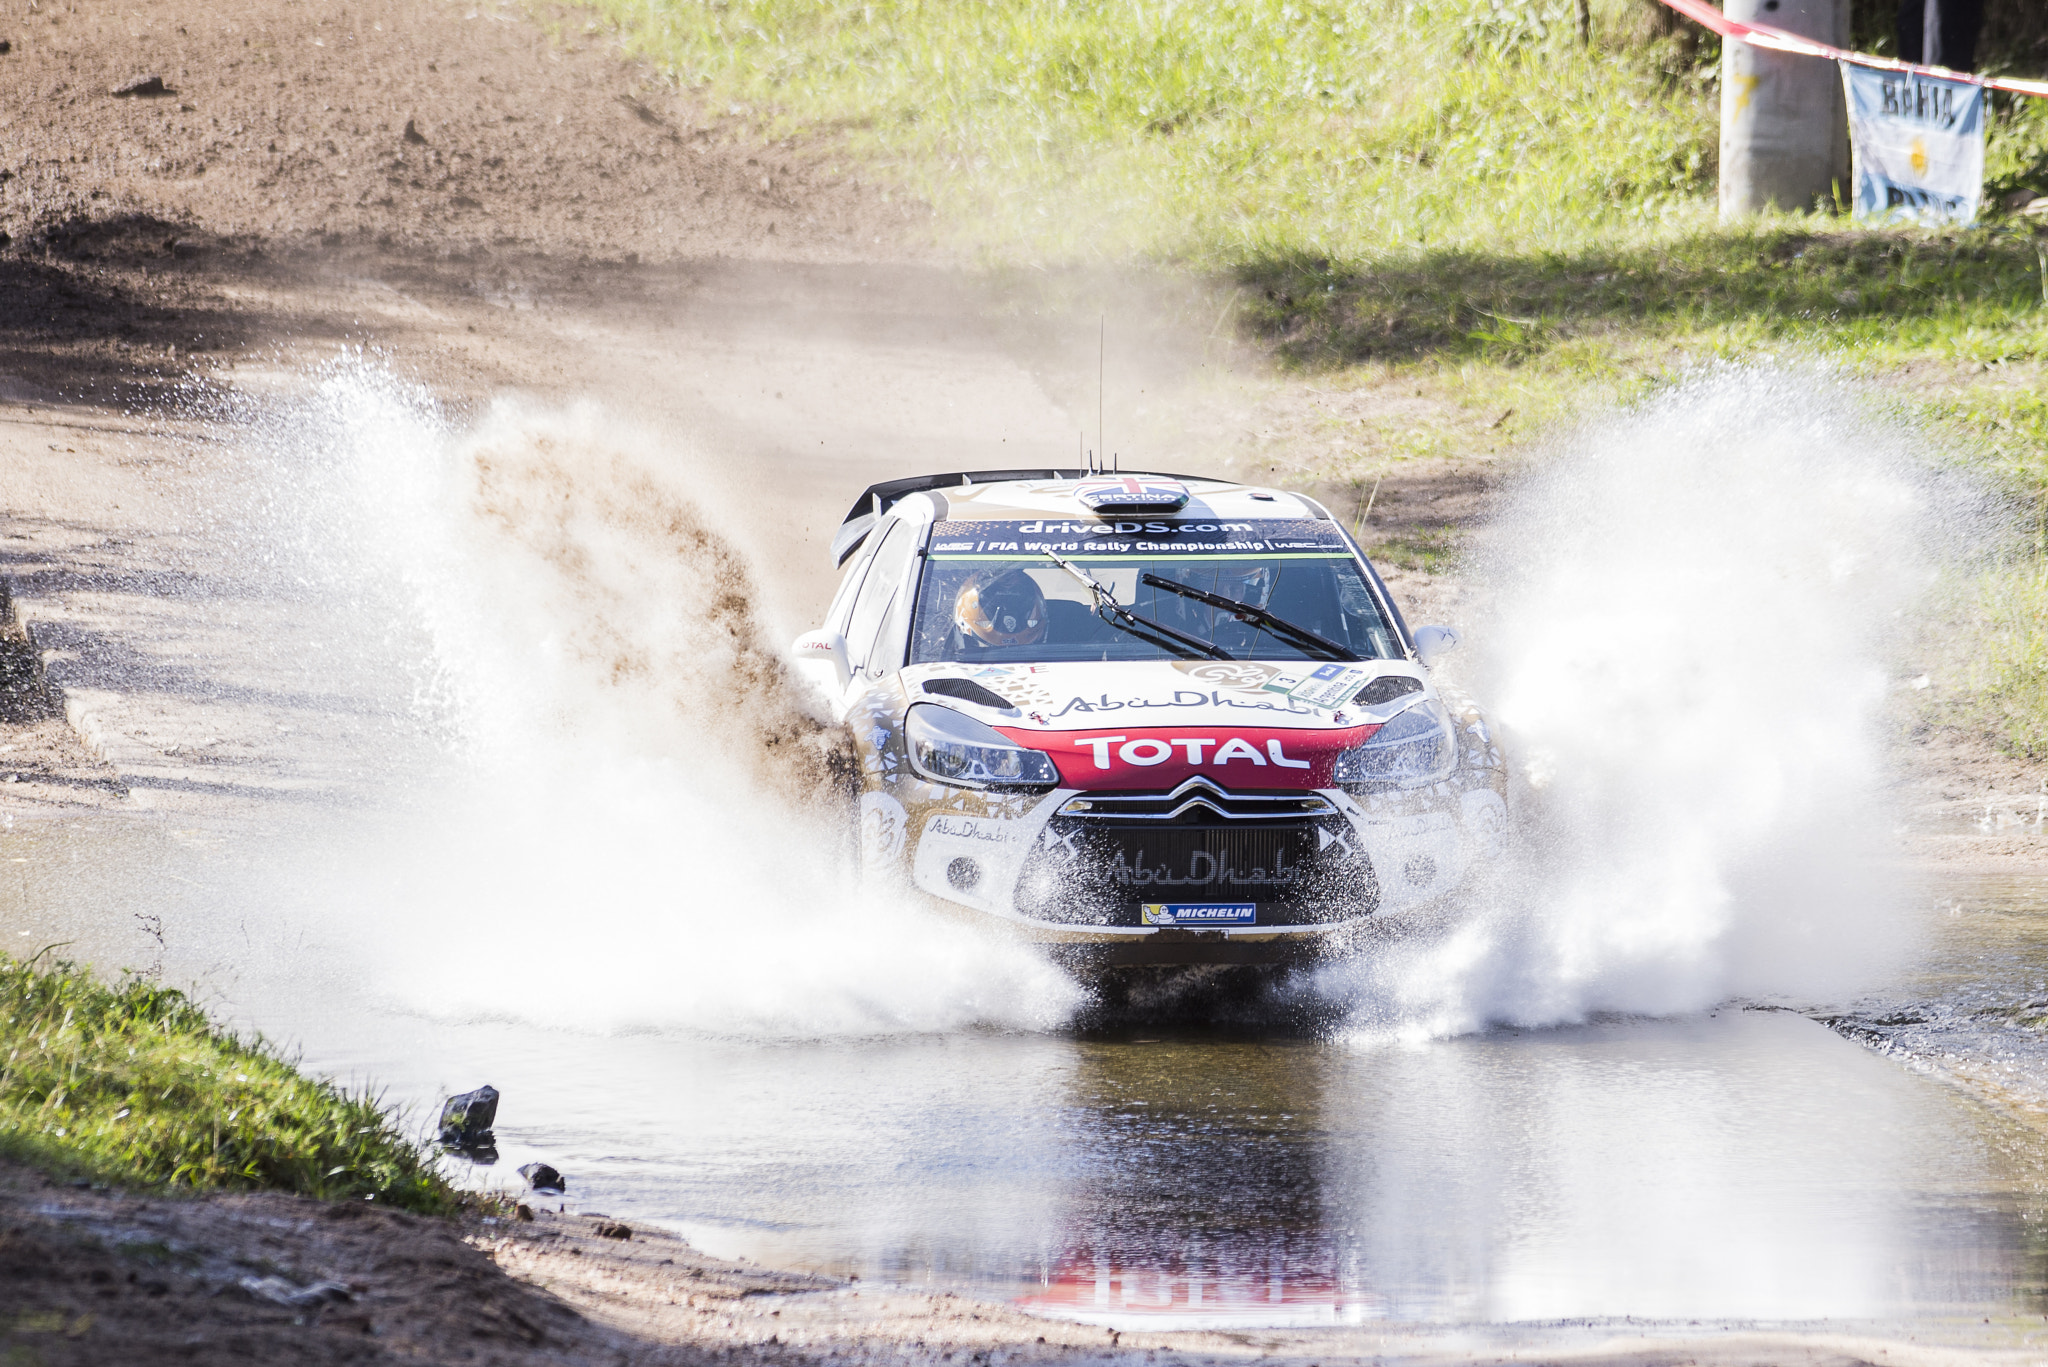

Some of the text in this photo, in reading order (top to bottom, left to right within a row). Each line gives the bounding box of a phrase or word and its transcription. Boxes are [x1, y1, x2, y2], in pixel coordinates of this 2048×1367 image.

[1019, 520, 1253, 535] driveDS.com
[988, 541, 1019, 551] FIA
[1024, 541, 1078, 551] World
[1083, 541, 1131, 552] Rally
[1135, 540, 1264, 552] Championship
[1074, 735, 1311, 770] TOTAL
[1175, 907, 1254, 918] MICHELIN
